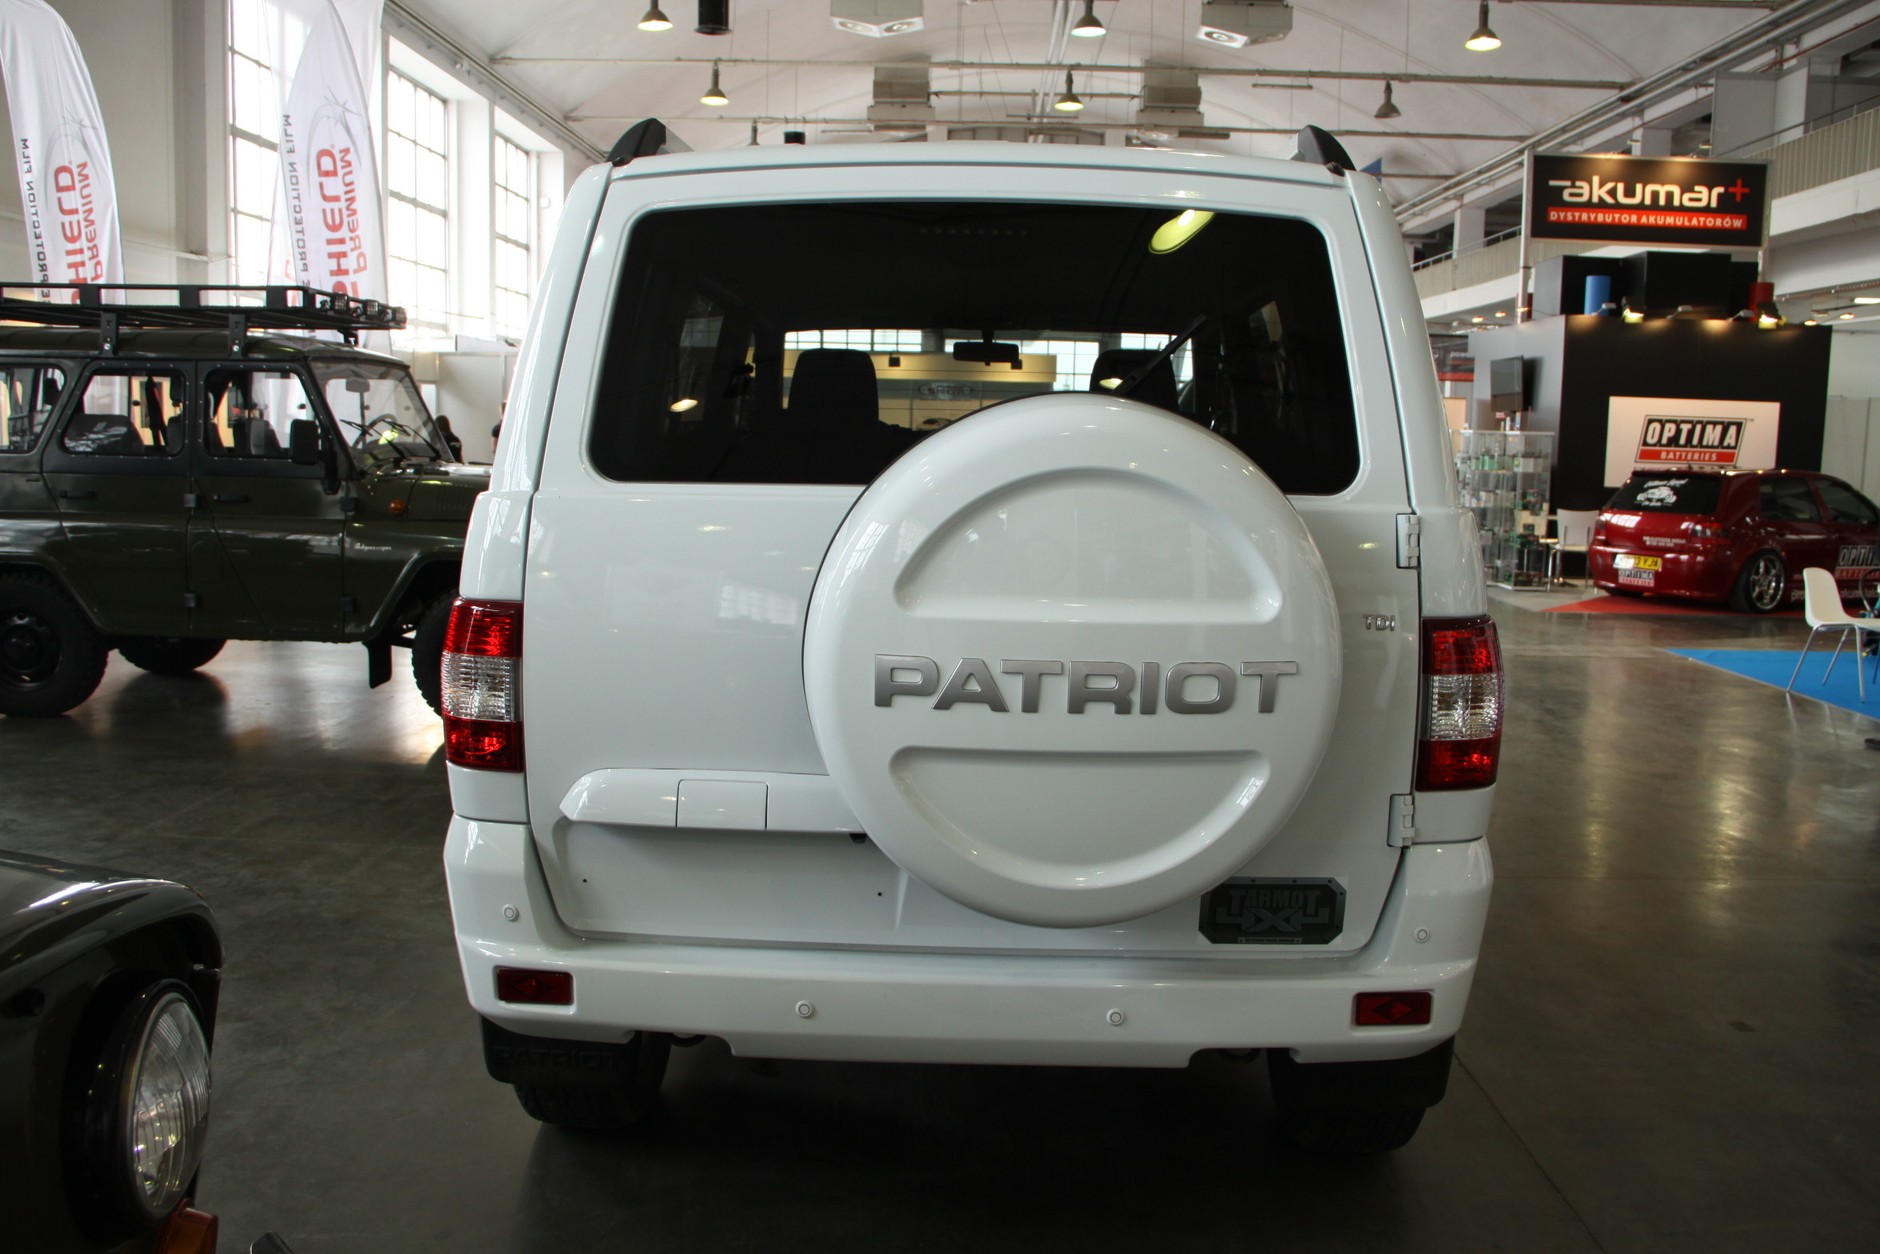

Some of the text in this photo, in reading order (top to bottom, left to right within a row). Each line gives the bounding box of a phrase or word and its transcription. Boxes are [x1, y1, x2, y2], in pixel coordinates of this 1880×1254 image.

[1550, 211, 1743, 228] DYSTRYBUTOR AKUMULATORÓW
[1645, 421, 1738, 447] OPTIMA
[1660, 451, 1717, 461] BATTERIES
[874, 654, 1298, 714] PATRIOT
[1228, 889, 1321, 916] TARMOT
